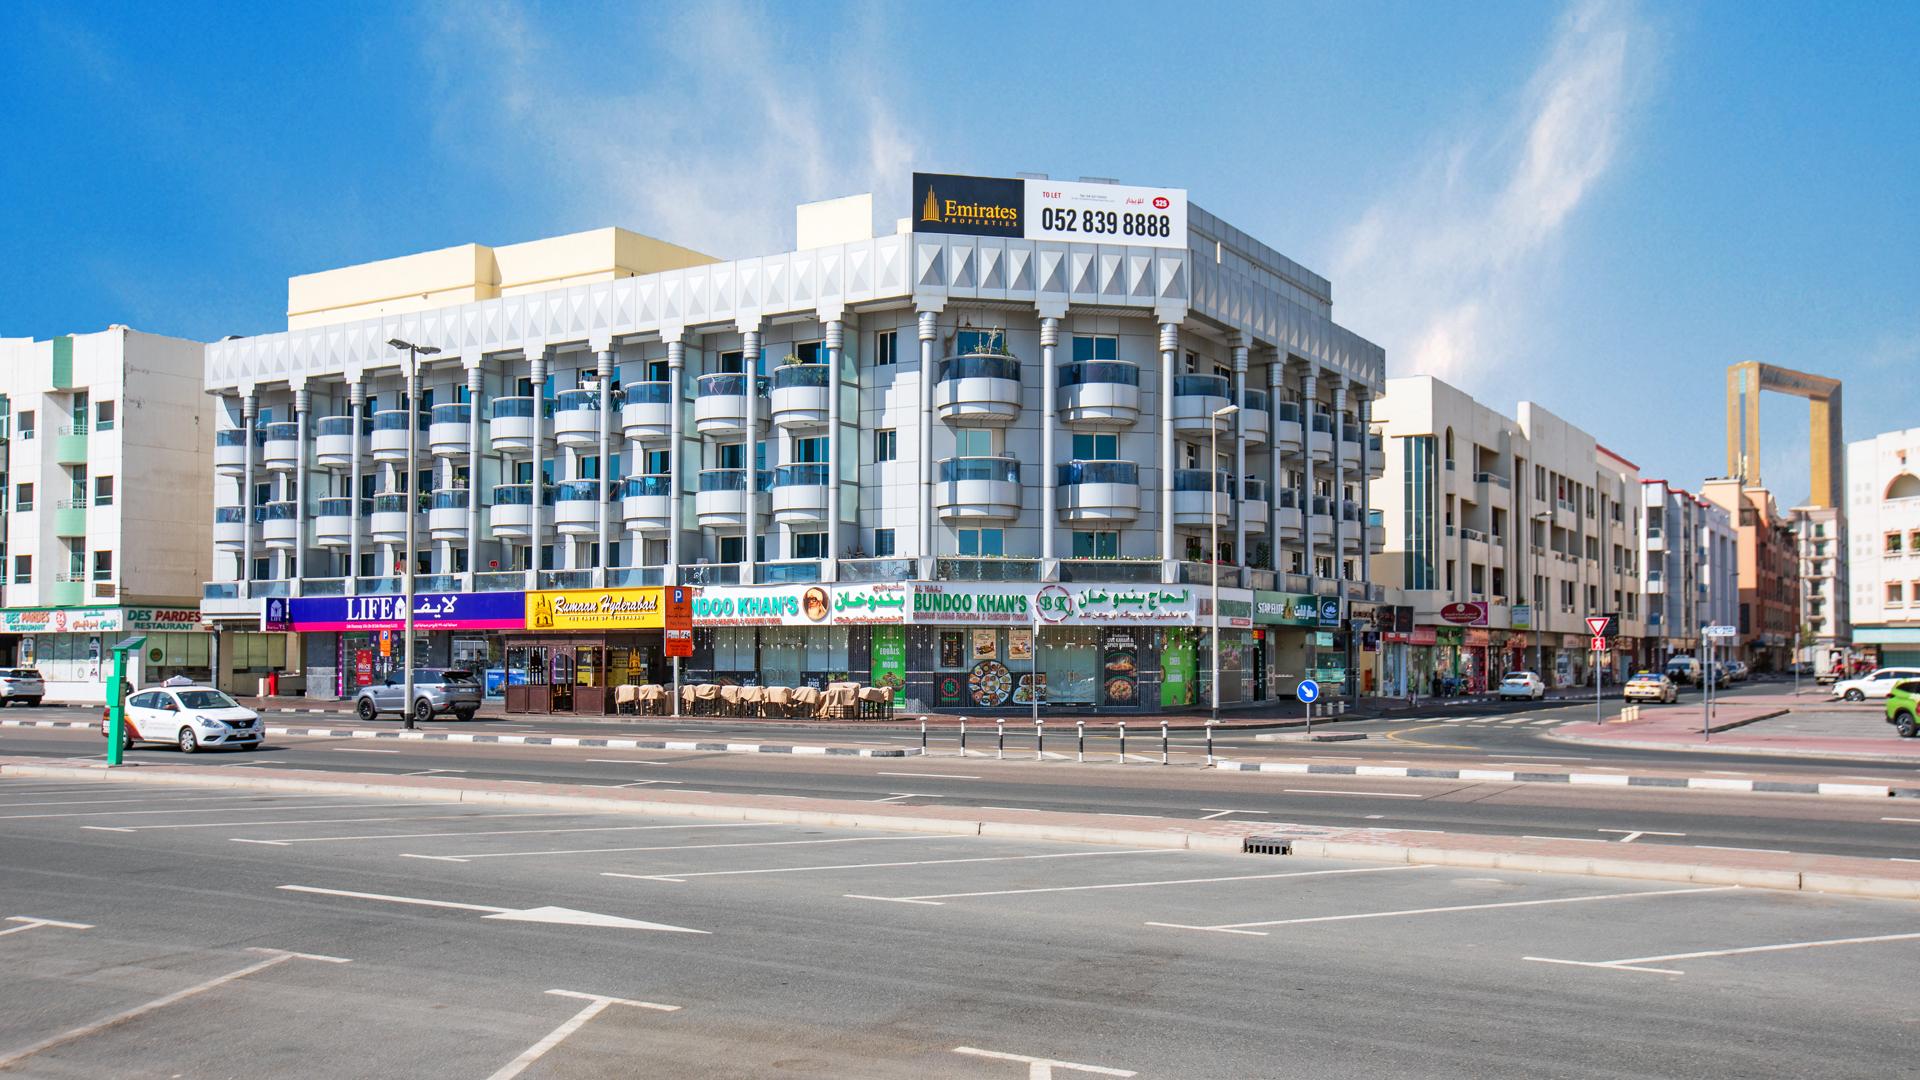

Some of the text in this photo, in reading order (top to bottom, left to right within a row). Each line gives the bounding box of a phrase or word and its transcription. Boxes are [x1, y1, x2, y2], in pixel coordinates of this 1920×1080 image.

[1043, 191, 1050, 199] TO
[944, 199, 1018, 220] Emirates
[944, 217, 1017, 228] PROPERTIES
[1042, 207, 1170, 238] 052 839 8888
[554, 595, 599, 614] Rumaan
[600, 594, 658, 616] Hyderabad
[675, 590, 682, 603] P
[692, 597, 734, 617] NDOO
[738, 595, 799, 617] KHAN'S
[914, 593, 1027, 612] BUNDOO KHAN'S
[1078, 588, 1189, 611] الحاج بندو خان
[128, 609, 201, 623] DES PARDES
[346, 597, 393, 621] LIFE
[134, 622, 194, 631] RESTAURANT
